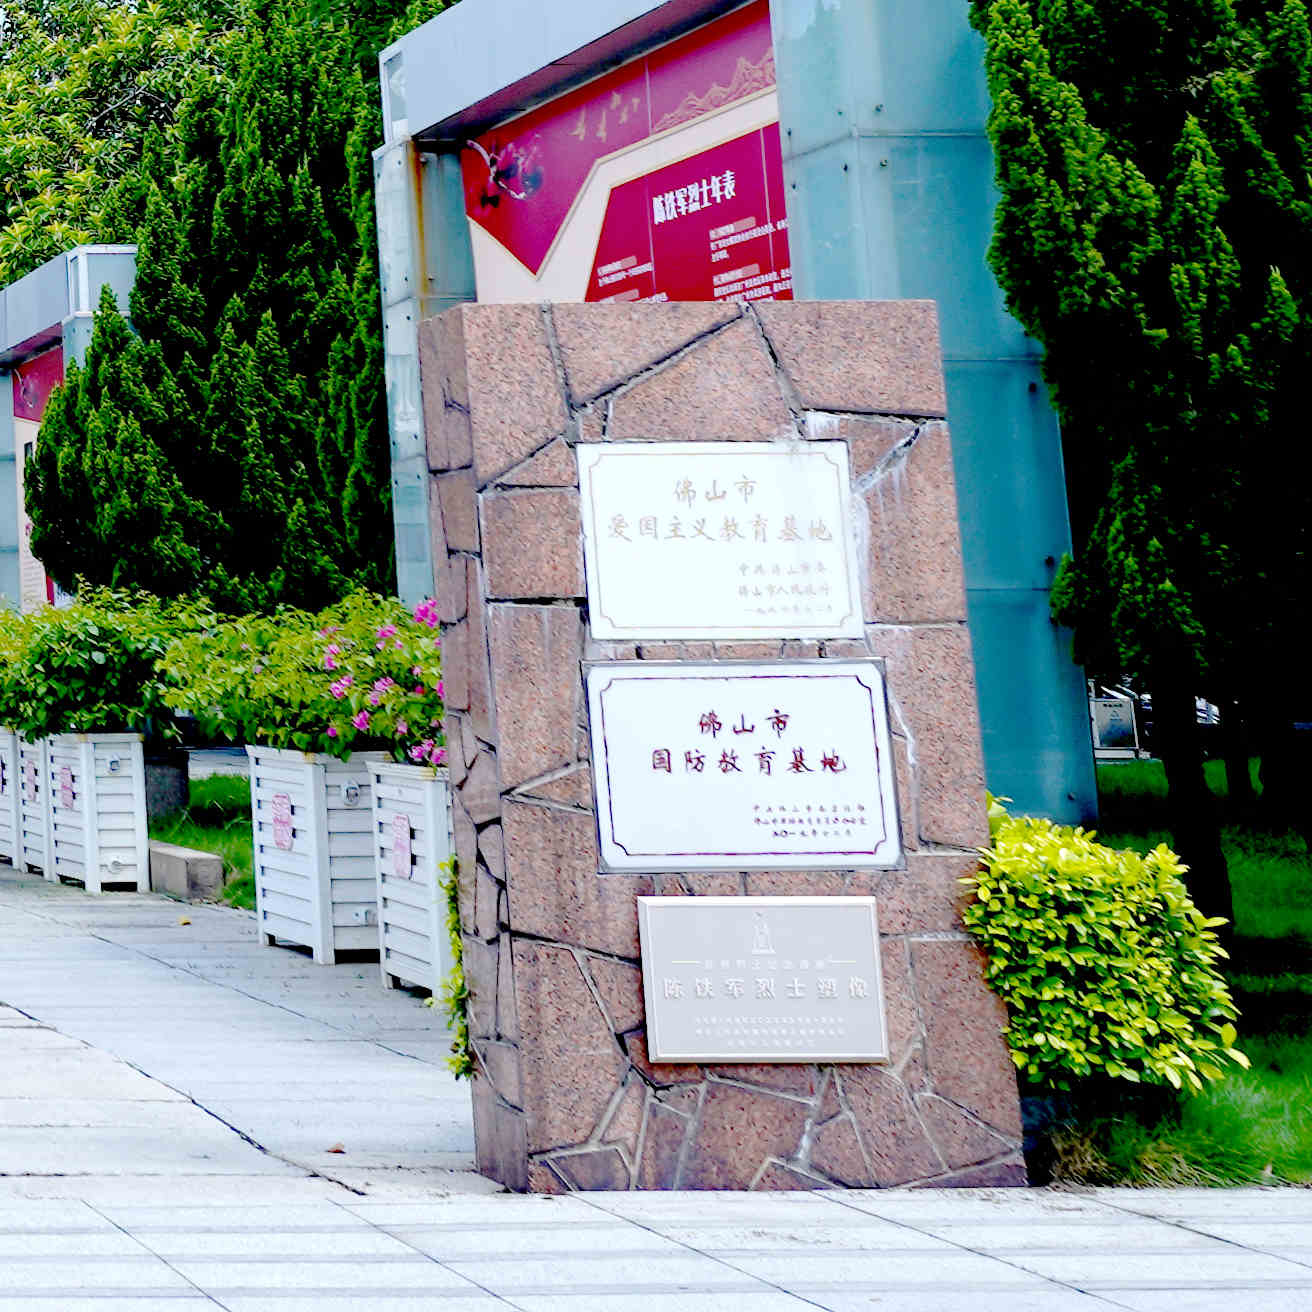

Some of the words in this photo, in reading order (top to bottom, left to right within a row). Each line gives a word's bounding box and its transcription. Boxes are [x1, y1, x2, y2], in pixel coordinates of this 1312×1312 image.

[652, 169, 737, 225] 陈铁军烈士年表
[673, 472, 757, 509] 佛山市
[608, 513, 833, 543] 爱国主义教育基地
[699, 708, 790, 739] 佛山市
[651, 746, 847, 776] 国防教育基地
[663, 975, 870, 1000] 陈铁军烈士塑像
